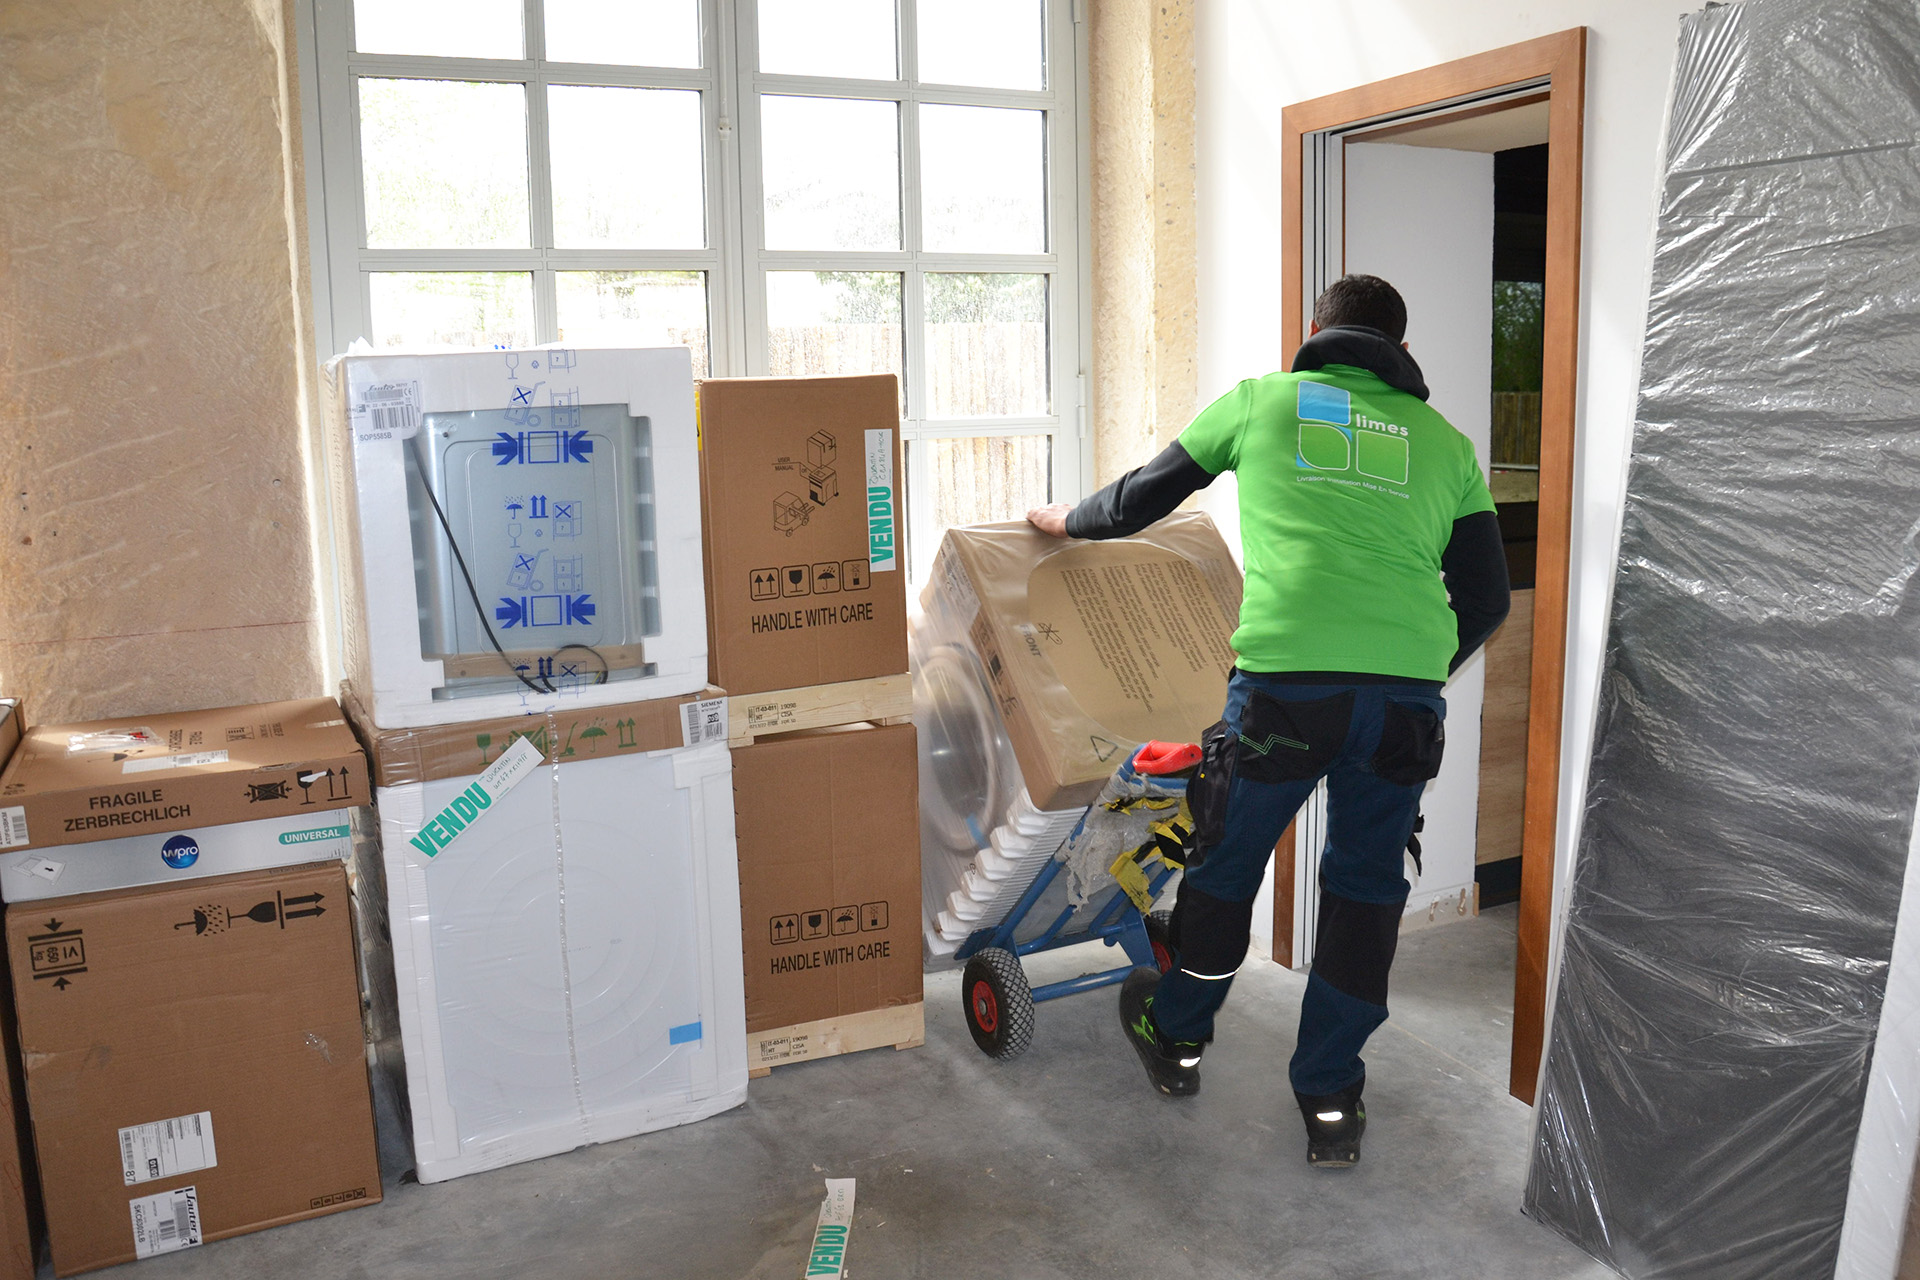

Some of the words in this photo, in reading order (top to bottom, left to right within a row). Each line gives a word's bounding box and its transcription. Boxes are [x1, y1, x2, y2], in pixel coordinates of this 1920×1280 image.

[1356, 414, 1409, 436] limes
[868, 486, 892, 563] VENDU
[752, 610, 802, 634] HANDLE
[806, 606, 836, 627] WITH
[840, 602, 873, 622] CARE
[1020, 624, 1042, 658] FRONT
[89, 788, 164, 810] FRAGILE
[64, 804, 191, 833] ZERBRECHLICH
[409, 782, 492, 858] VENDU
[284, 828, 340, 844] UNIVERSAL
[163, 845, 198, 860] wpro
[770, 950, 821, 974] HANDLE
[823, 946, 855, 968] WITH
[857, 940, 890, 962] CARE
[126, 1170, 136, 1183] 87
[186, 1192, 197, 1233] Sauter
[807, 1224, 848, 1276] VENDU
